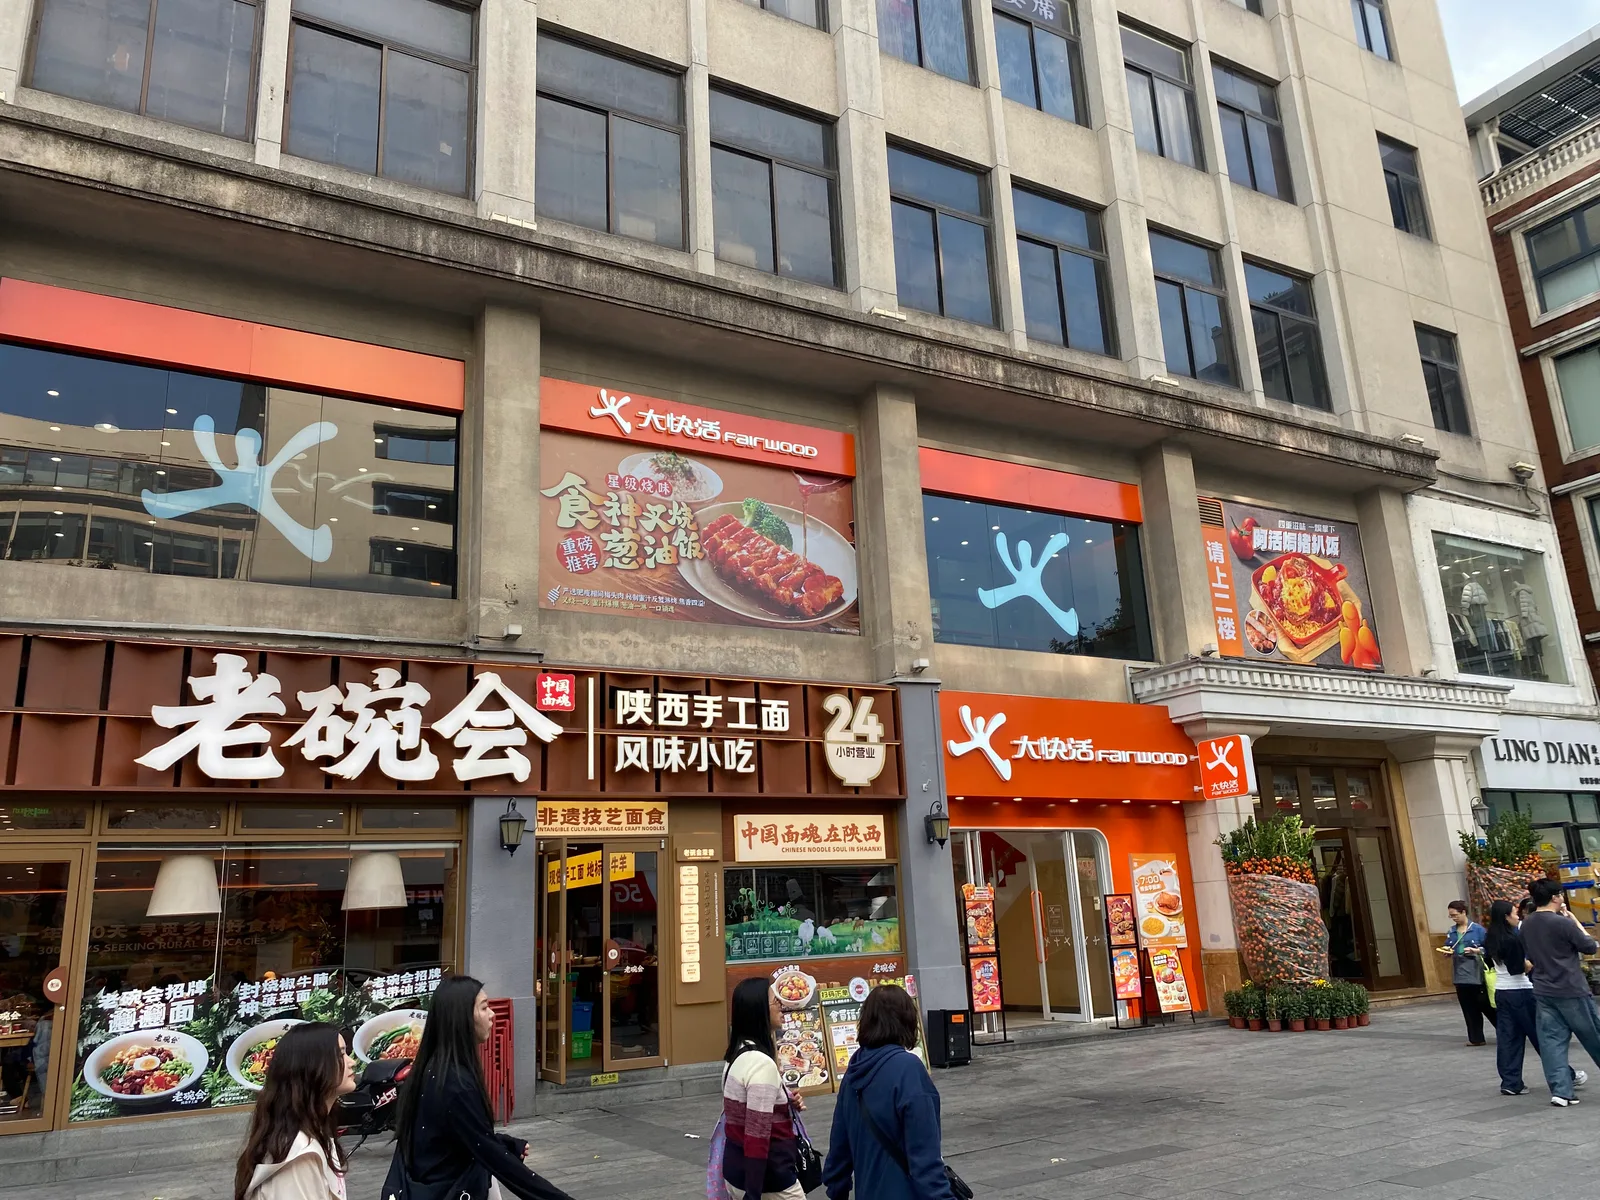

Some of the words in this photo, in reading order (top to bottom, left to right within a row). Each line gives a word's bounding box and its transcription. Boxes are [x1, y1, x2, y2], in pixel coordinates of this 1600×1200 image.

[637, 408, 721, 441] 大快活
[606, 473, 671, 496] 星级烧味
[540, 472, 699, 534] 食神叉烧
[560, 536, 593, 556] 重磅
[600, 528, 705, 571] 葱油饭
[565, 553, 599, 573] 推荐
[1206, 540, 1237, 641] 请上二楼
[542, 676, 570, 694] 中国
[542, 693, 571, 707] 面魂
[616, 689, 790, 732] 陕西手工面
[135, 652, 564, 782] 老碗会
[823, 694, 884, 742] 24
[615, 736, 756, 773] 风味小吃
[836, 747, 875, 759] 小时营业
[1012, 735, 1093, 762] 大快活
[1490, 738, 1540, 762] LING
[1543, 741, 1591, 765] DIAN
[1211, 779, 1239, 792] 大快活
[537, 807, 665, 825] 非遗技艺面食
[741, 821, 882, 850] 中国面魂在陕西
[1139, 875, 1159, 885] 7:00
[104, 941, 156, 953] SEEKING
[158, 939, 200, 950] RURAL
[372, 967, 442, 989] 老碗会招牌
[624, 964, 645, 973] 老碗会
[873, 962, 897, 973] 老碗会
[262, 972, 330, 994] 烧椒牛腩
[98, 979, 207, 1010] 老碗会招牌
[262, 988, 311, 1008] 菠菜面
[820, 989, 849, 999] 扫码下单
[154, 1033, 181, 1045] 老碗会
[171, 1089, 207, 1102] 老碗会
